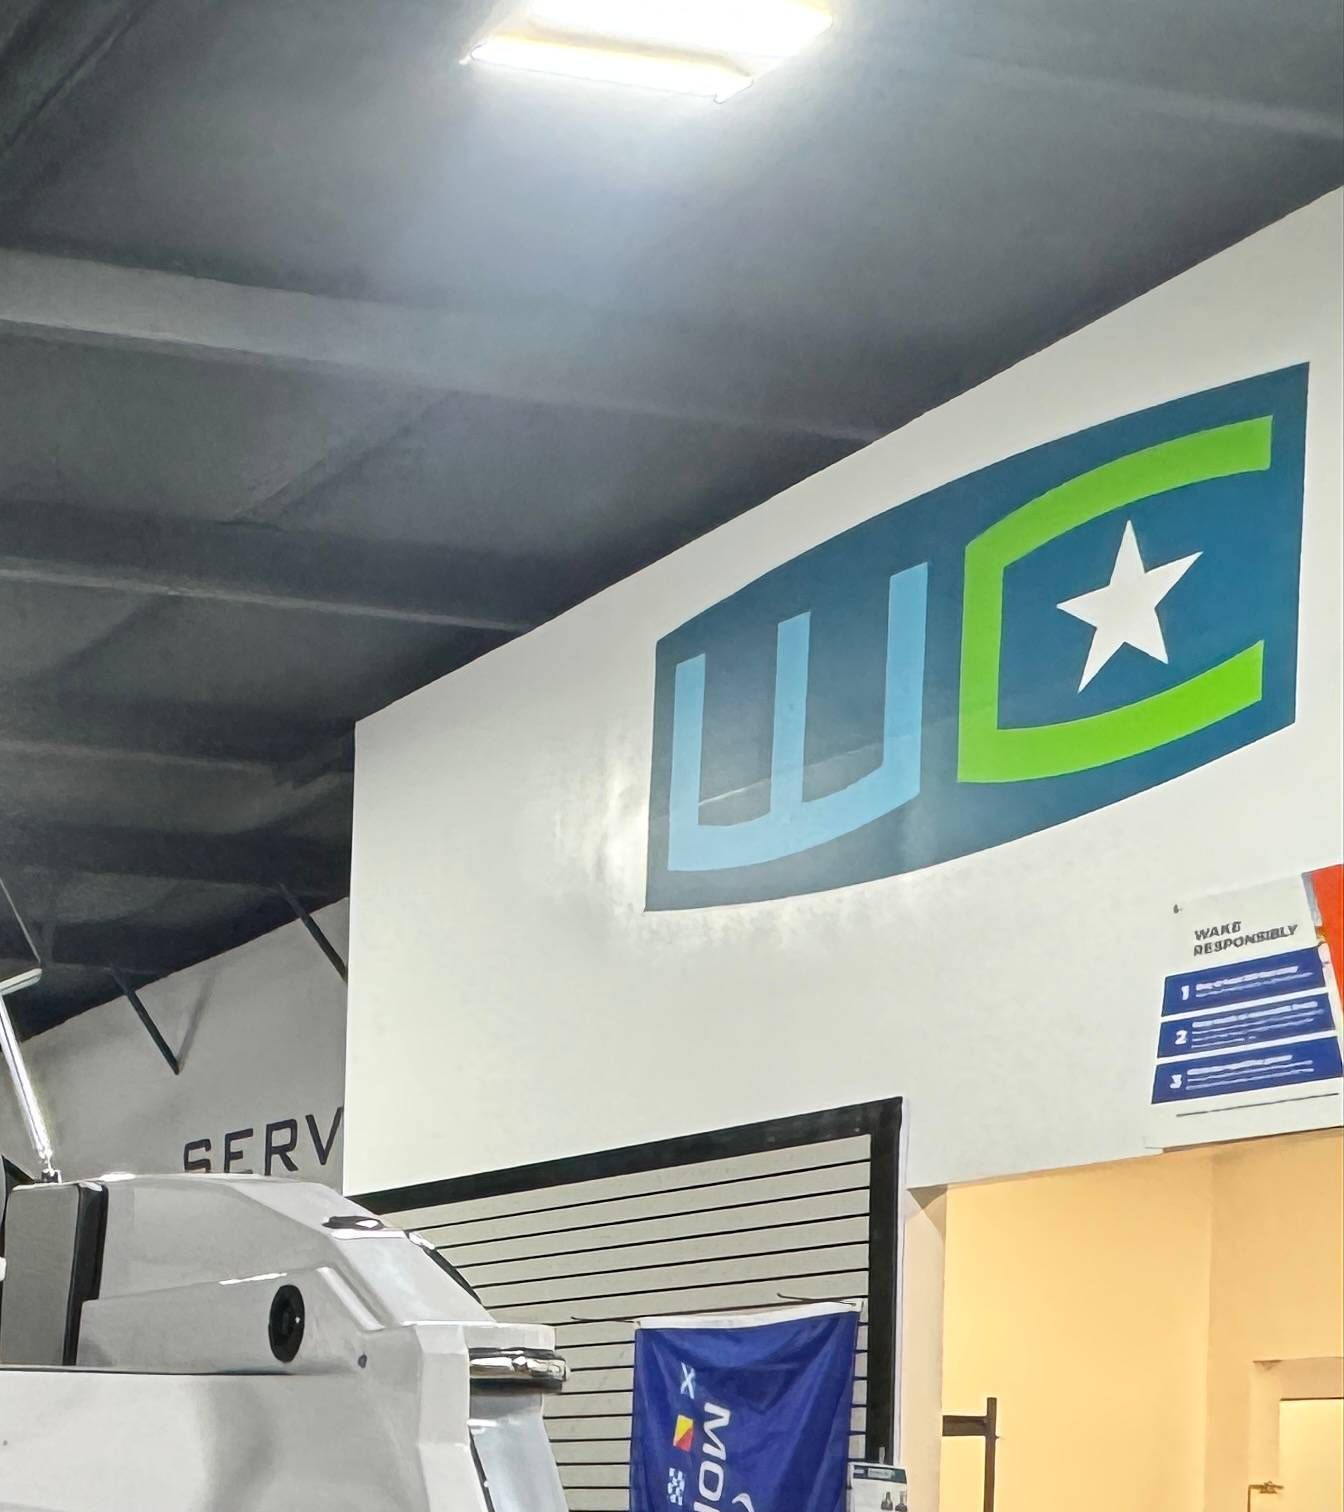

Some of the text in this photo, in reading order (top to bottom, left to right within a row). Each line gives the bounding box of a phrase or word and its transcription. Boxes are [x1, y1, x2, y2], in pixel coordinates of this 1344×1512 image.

[1194, 920, 1242, 941] WAKE
[1193, 924, 1298, 957] RESPONSIBLY
[1181, 985, 1190, 1001] 1
[1175, 1030, 1187, 1045] 2
